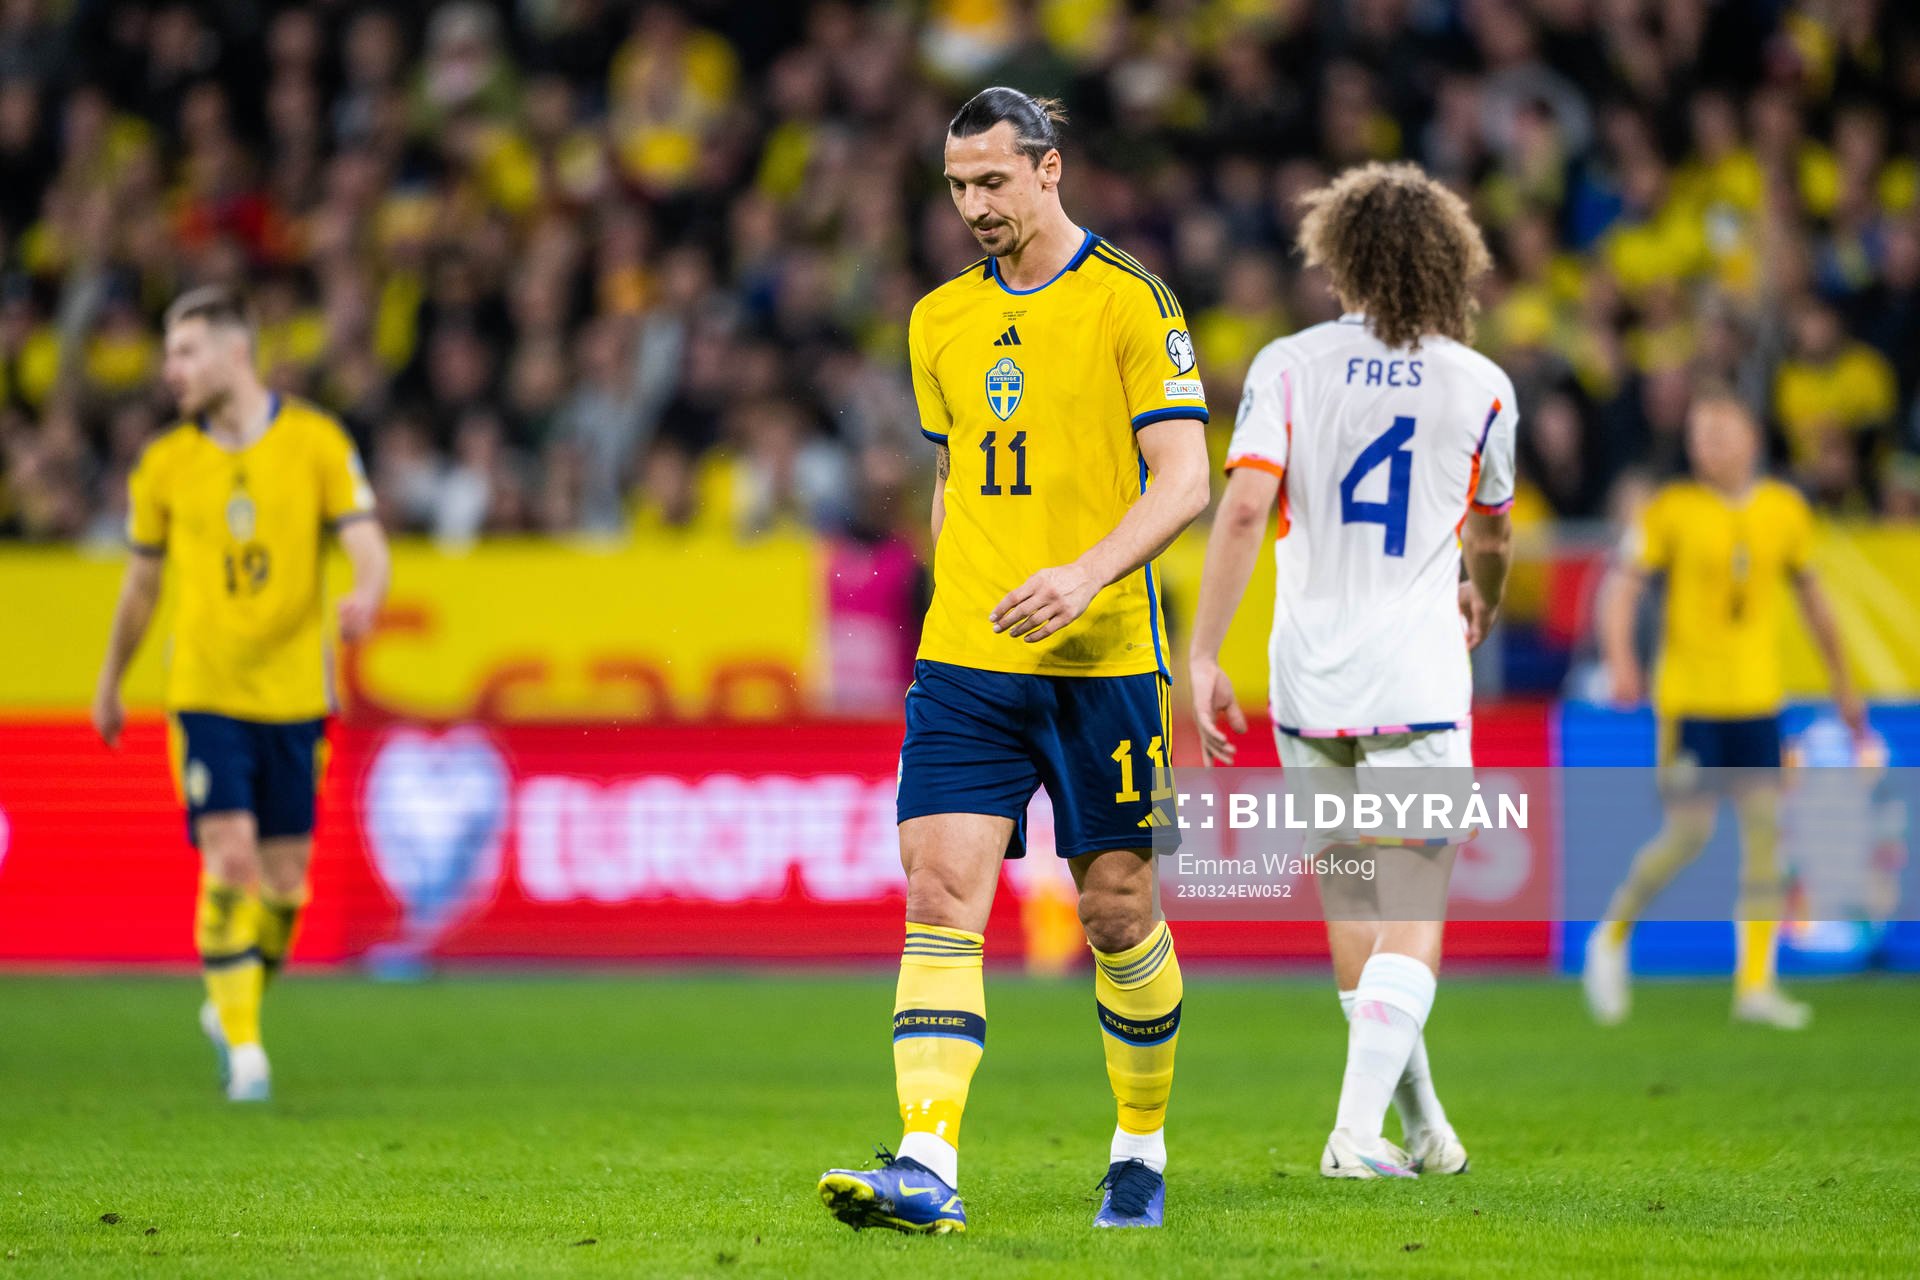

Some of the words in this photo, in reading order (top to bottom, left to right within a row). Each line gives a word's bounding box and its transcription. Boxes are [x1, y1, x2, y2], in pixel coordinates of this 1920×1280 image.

[1346, 358, 1424, 387] FAES
[979, 431, 1032, 496] 11
[1340, 415, 1416, 558] 4
[222, 544, 271, 597] 19
[1111, 735, 1172, 804] 11
